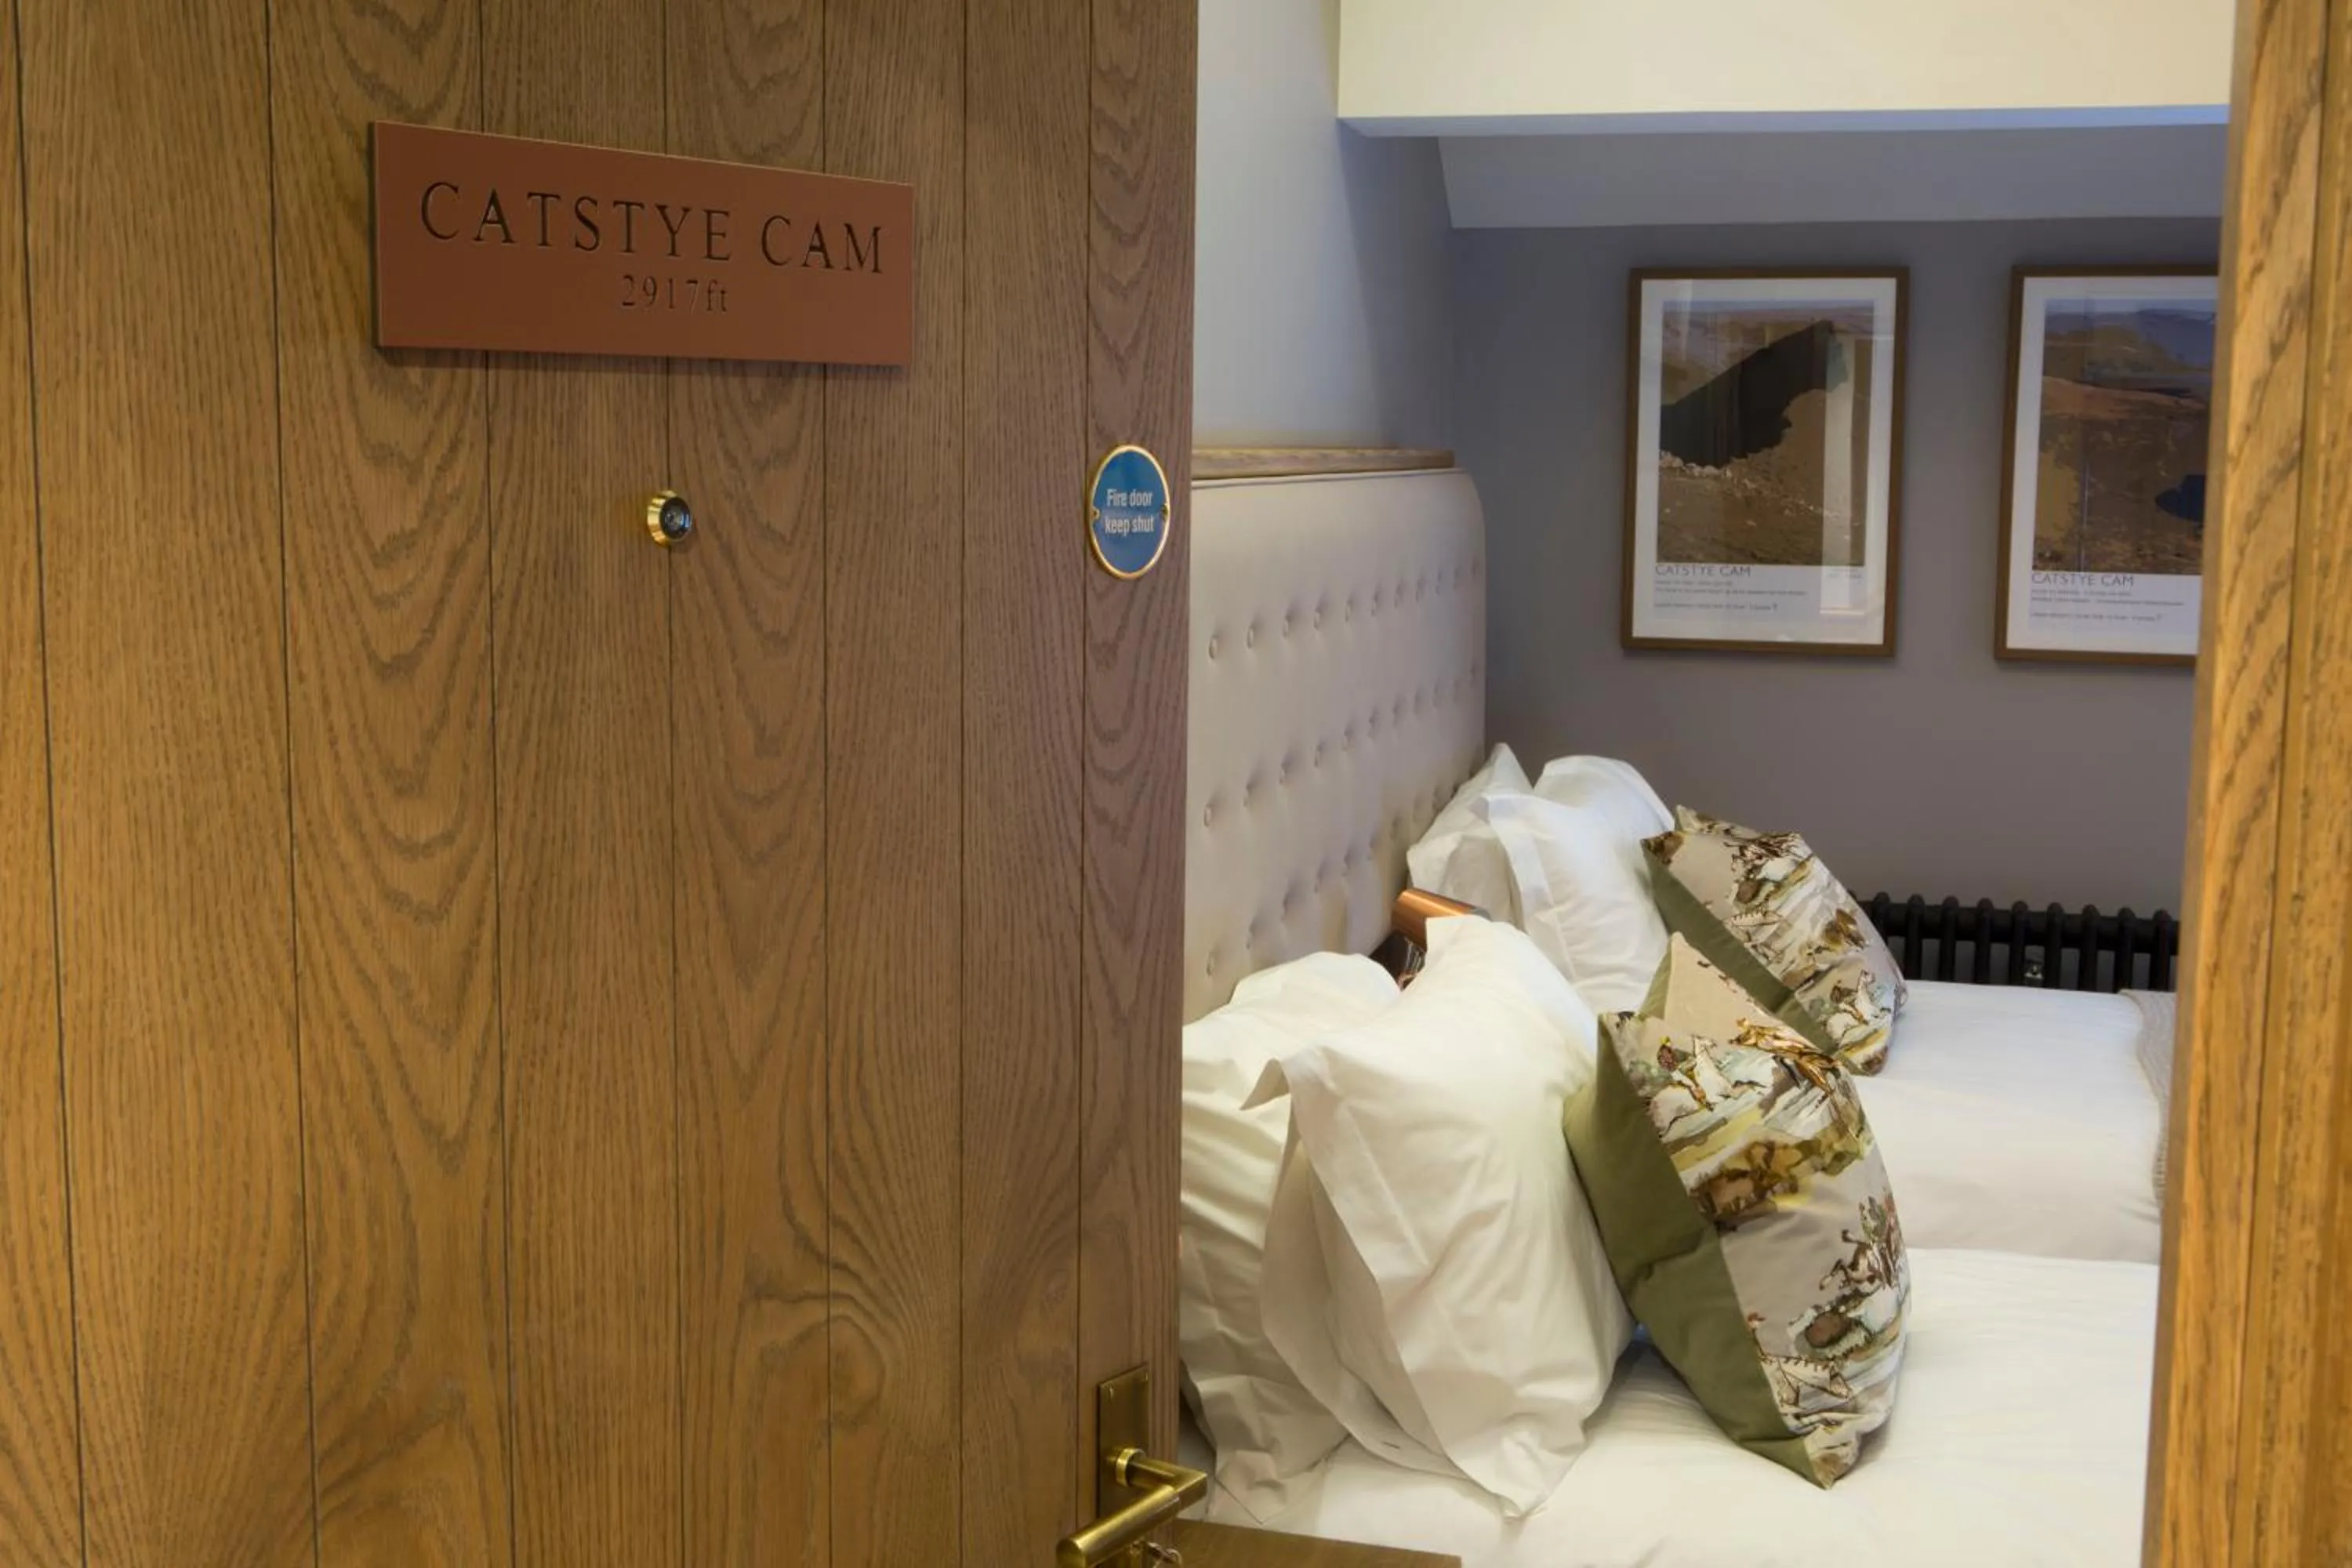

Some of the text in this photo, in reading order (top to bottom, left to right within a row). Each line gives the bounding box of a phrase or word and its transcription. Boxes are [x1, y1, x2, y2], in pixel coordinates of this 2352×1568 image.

[420, 181, 884, 274] CATSTYE CAM
[622, 274, 728, 313] 2917ft
[1106, 488, 1153, 506] Fire door
[1104, 516, 1155, 536] keep shut
[1655, 564, 1751, 577] CATSTYE CAM
[2031, 572, 2135, 586] CATSTYE CAM
